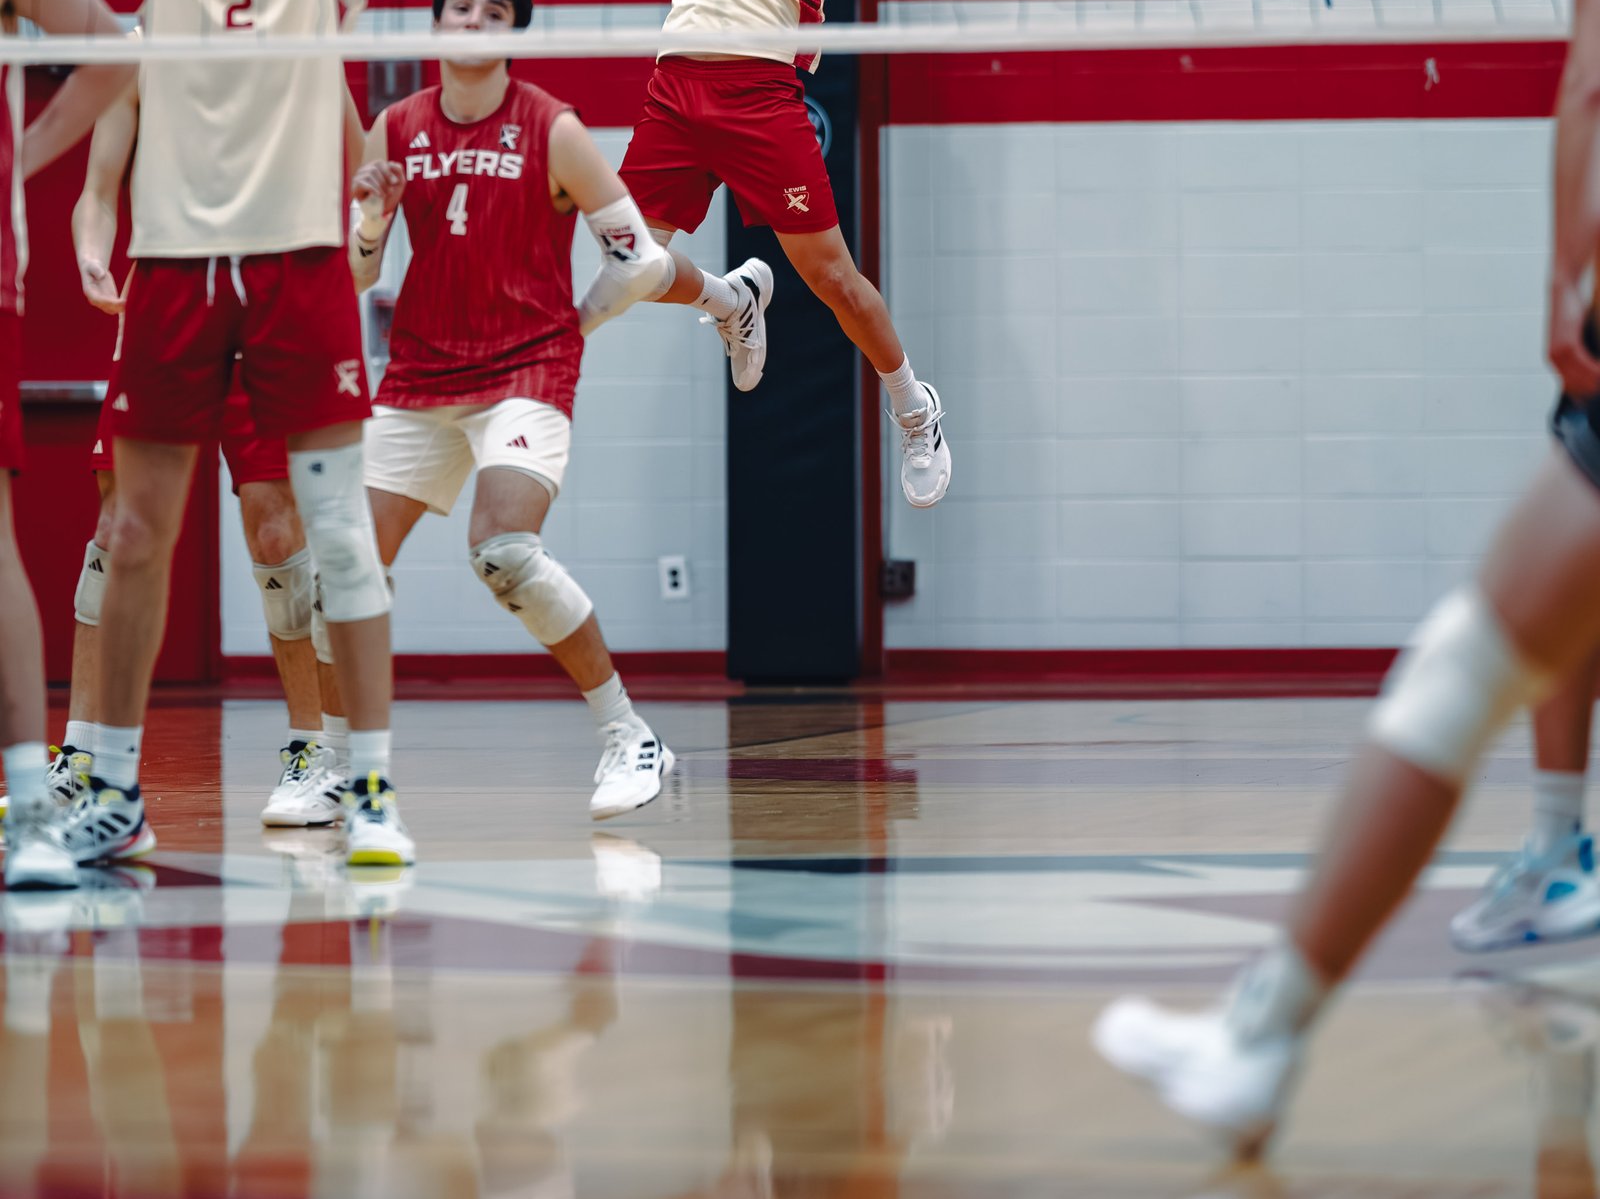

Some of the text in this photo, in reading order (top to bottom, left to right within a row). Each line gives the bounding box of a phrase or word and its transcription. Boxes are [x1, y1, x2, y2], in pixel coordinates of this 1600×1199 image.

[405, 150, 524, 181] FLYERS
[783, 185, 807, 194] LEWIS
[446, 183, 469, 235] 4
